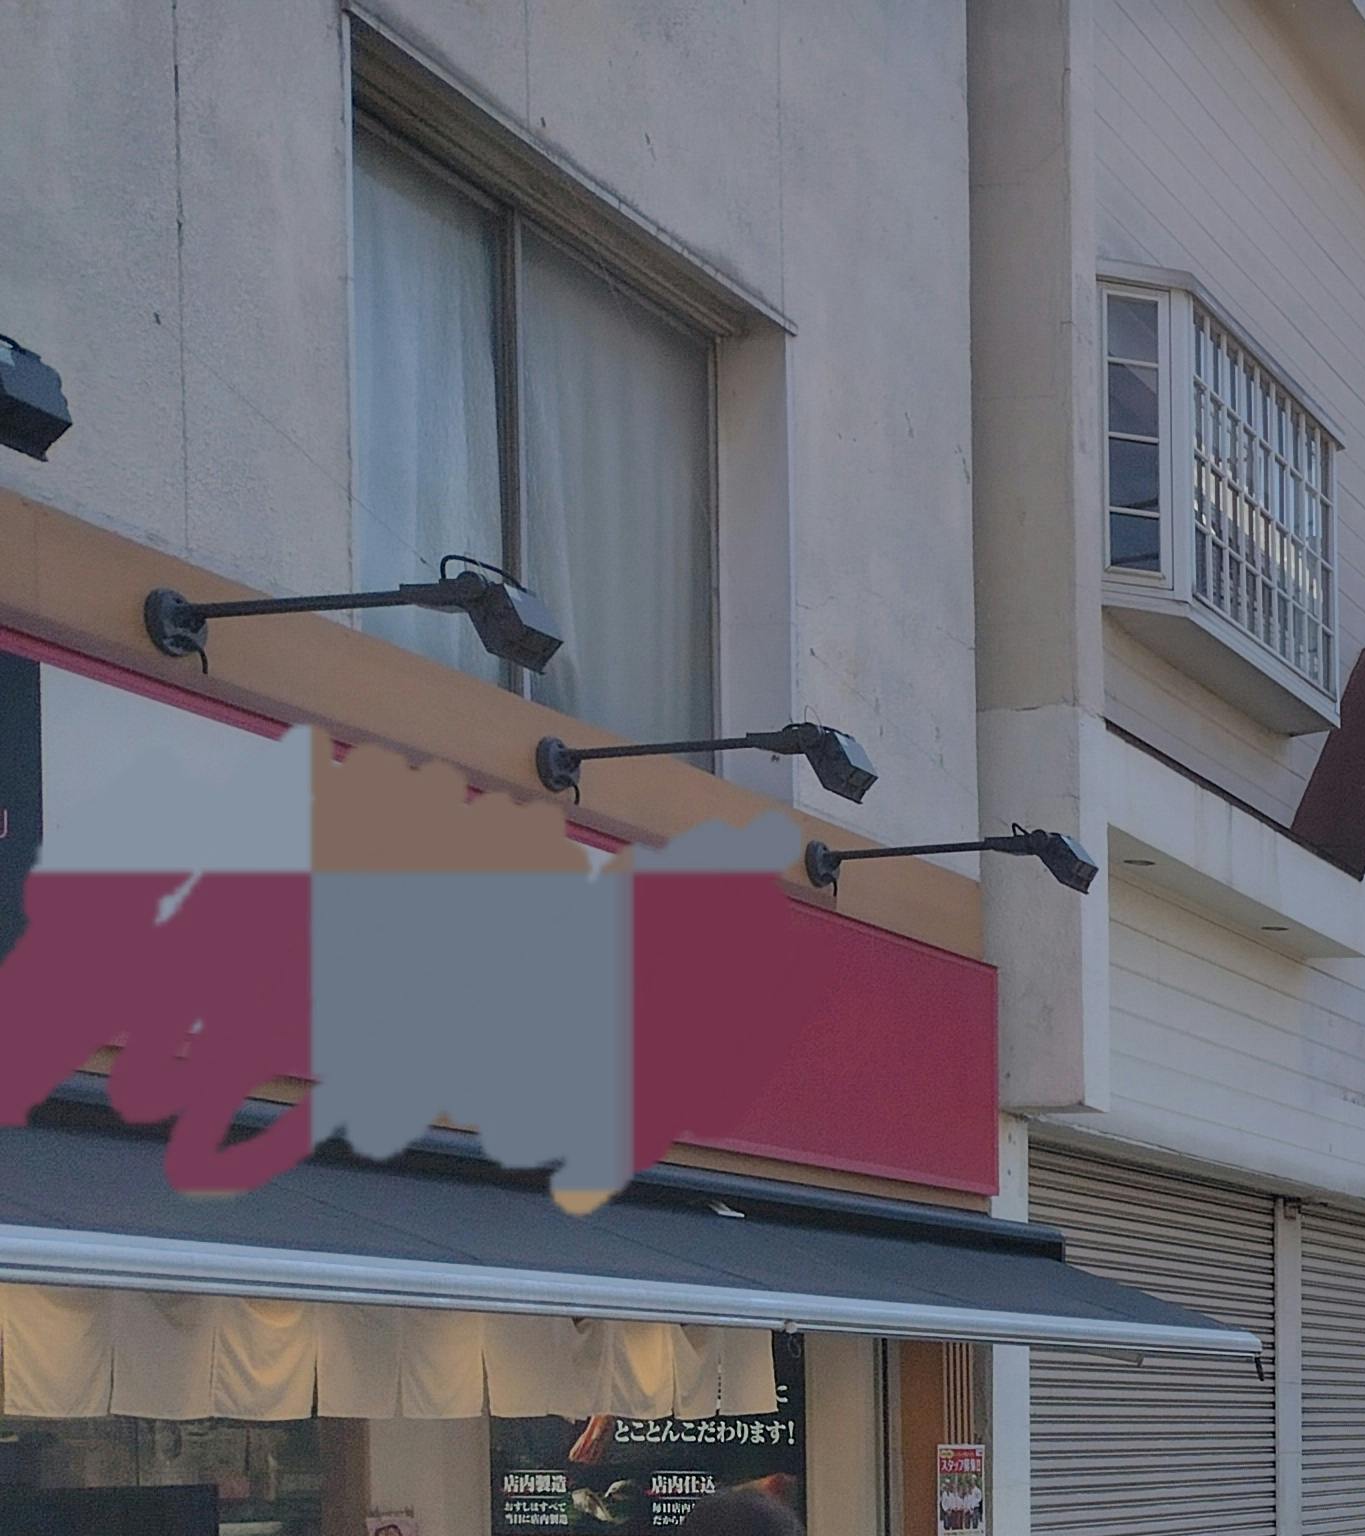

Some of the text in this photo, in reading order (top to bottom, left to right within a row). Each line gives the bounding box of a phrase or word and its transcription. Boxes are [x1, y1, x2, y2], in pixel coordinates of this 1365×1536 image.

[614, 1420, 796, 1446] とことんこだわります!
[503, 1474, 568, 1494] 店内製造
